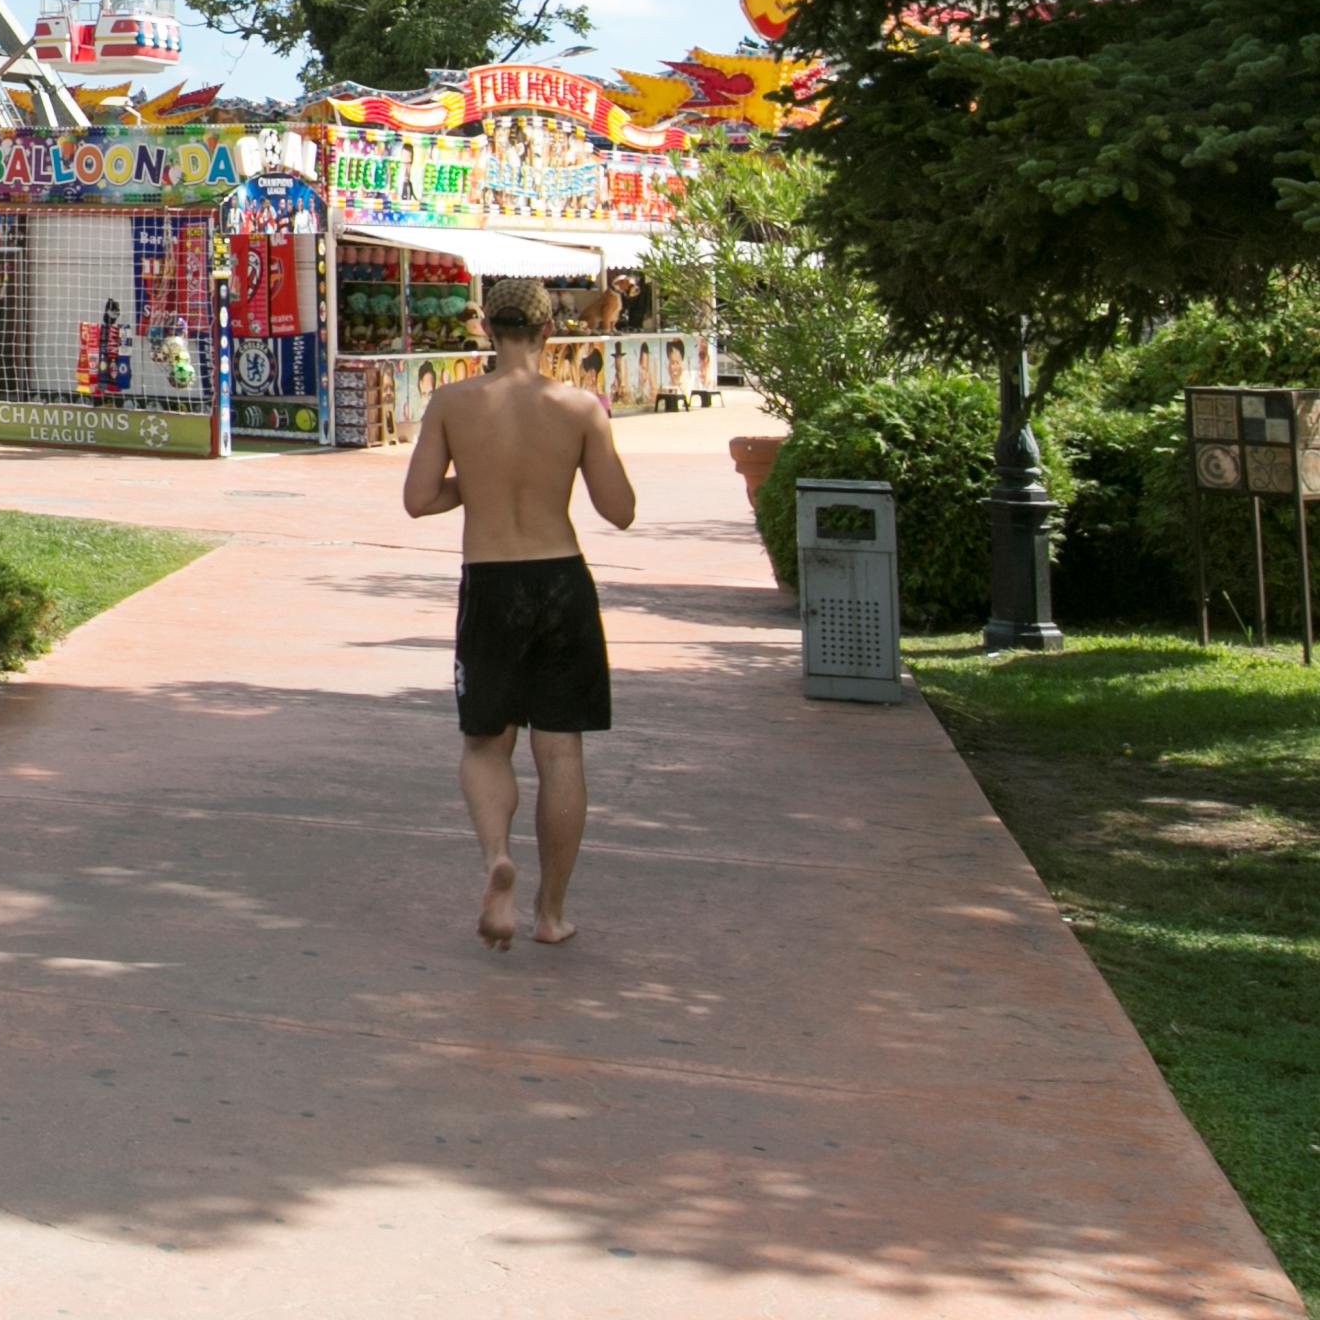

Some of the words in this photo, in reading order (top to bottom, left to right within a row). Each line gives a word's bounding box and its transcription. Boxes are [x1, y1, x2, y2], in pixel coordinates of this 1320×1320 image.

[479, 71, 522, 107] FUN
[527, 73, 591, 116] HOUSE
[336, 155, 402, 191] LUCKY
[258, 178, 294, 188] CHAMPIONS
[266, 187, 287, 196] LEAGUE
[30, 426, 97, 444] LEAGUE
